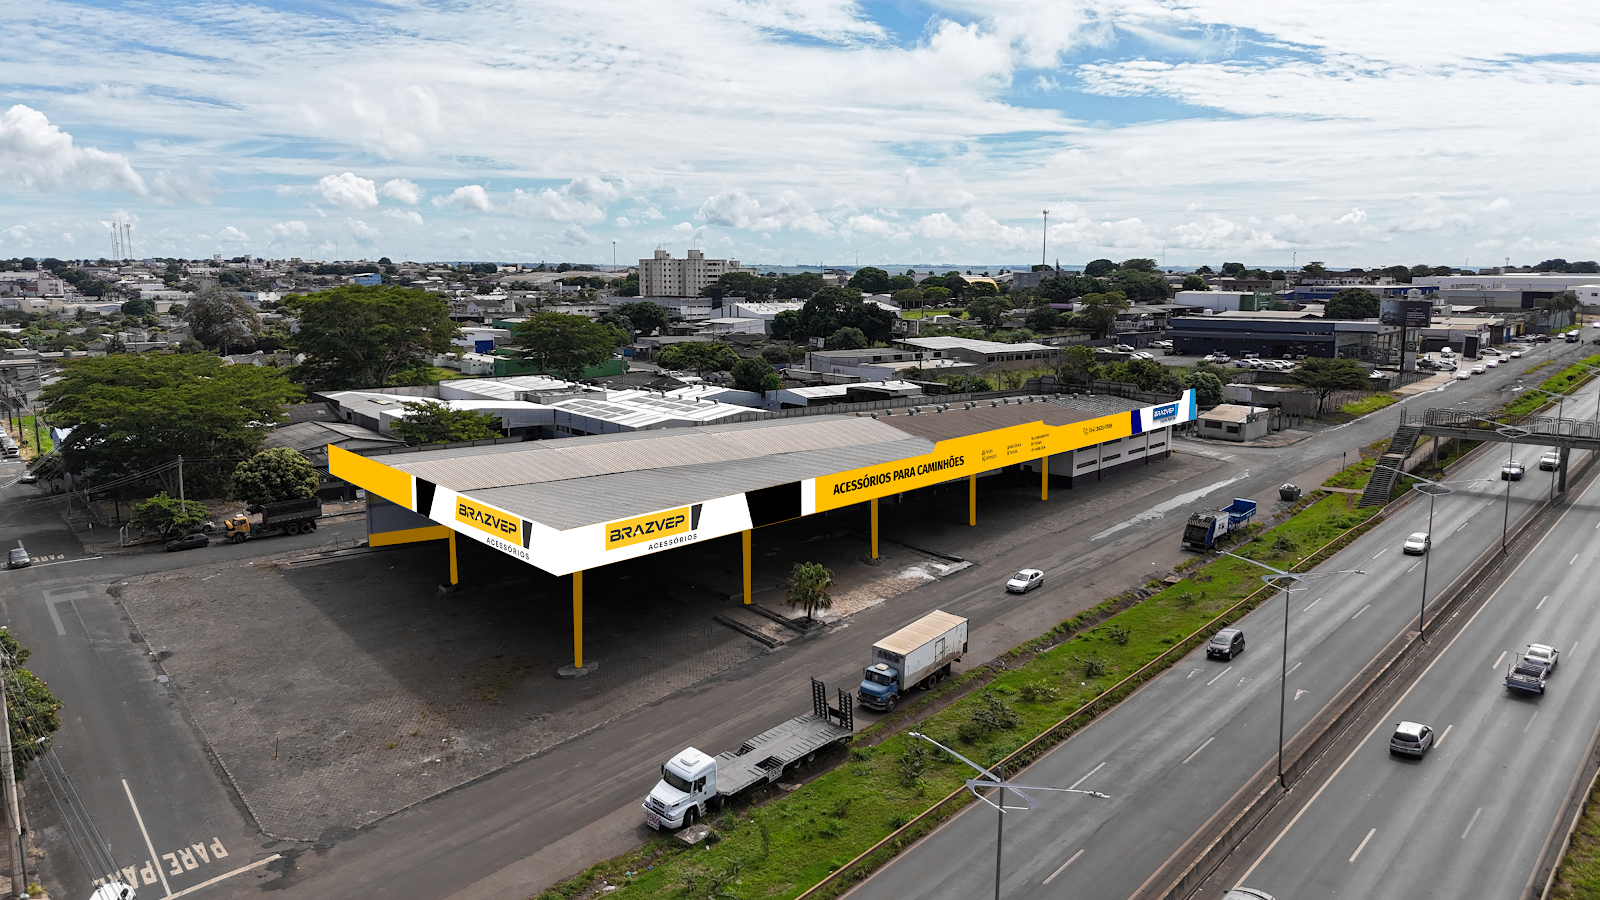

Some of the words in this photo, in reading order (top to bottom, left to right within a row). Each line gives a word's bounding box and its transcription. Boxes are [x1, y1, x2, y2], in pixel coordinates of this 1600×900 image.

[833, 474, 891, 495] ACESSÓRIOS
[893, 467, 916, 481] PARA
[917, 455, 965, 475] CAMINHÕES
[459, 503, 517, 534] BRAZVEP
[610, 514, 685, 542] BRAZVEP
[486, 537, 530, 560] ACESSÓRIOS
[648, 533, 698, 550] ACESSÓRIOS
[31, 553, 65, 563] PARE
[161, 836, 229, 876] PARE
